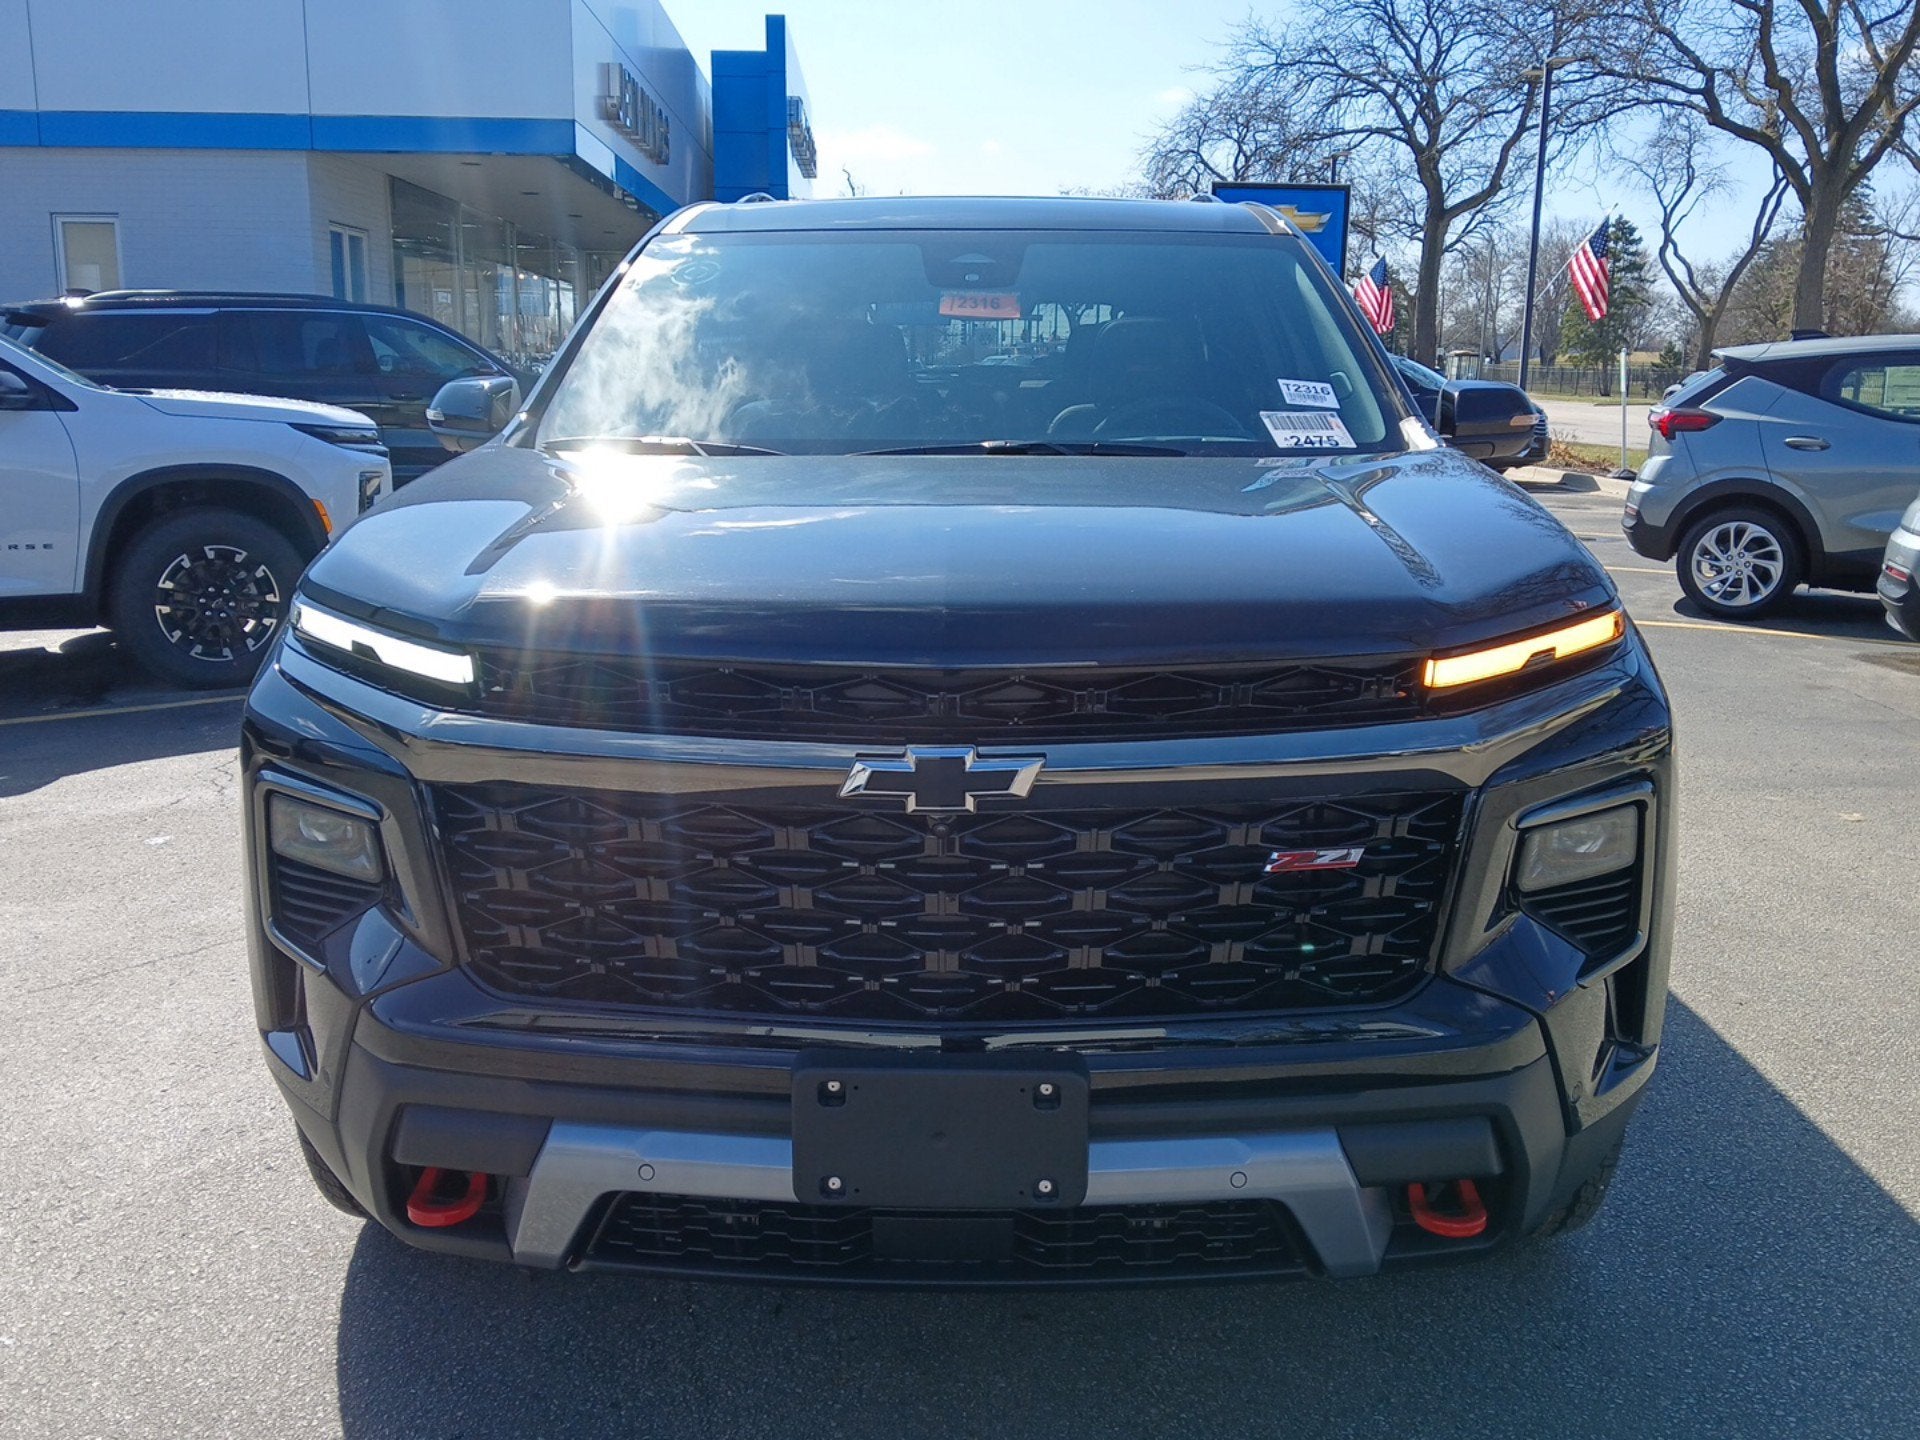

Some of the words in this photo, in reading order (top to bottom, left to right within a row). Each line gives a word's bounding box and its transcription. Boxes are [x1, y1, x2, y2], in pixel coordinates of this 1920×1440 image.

[1282, 383, 1331, 396] T2316
[1290, 435, 1340, 447] 2475
[1264, 848, 1365, 872] Z71
